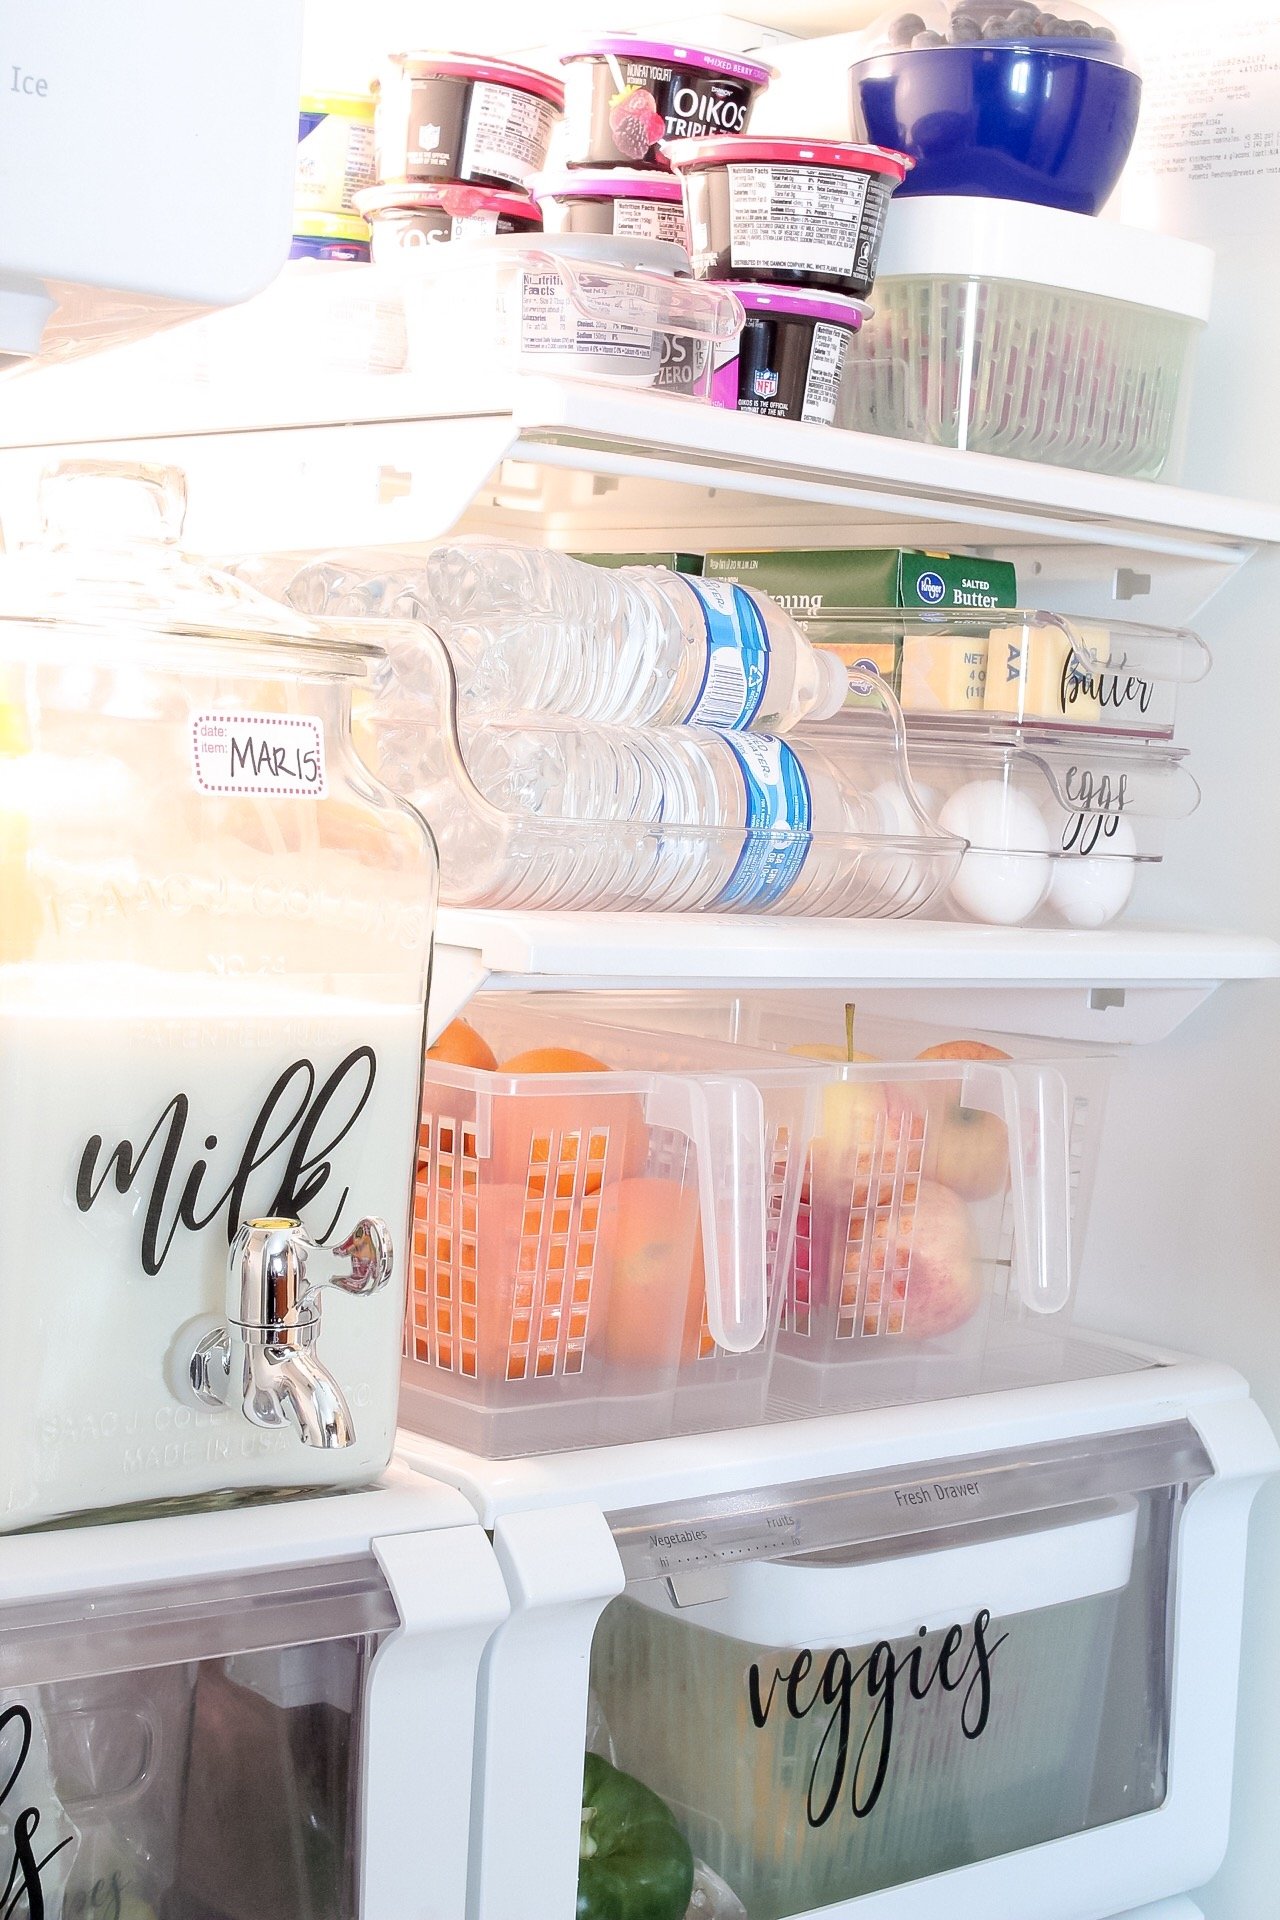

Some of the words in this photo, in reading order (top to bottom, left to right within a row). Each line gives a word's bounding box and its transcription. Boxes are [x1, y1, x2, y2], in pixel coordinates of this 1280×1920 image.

[627, 63, 649, 79] NONFAT
[649, 66, 672, 82] YOGURT
[11, 65, 48, 97] Ice
[673, 88, 747, 131] OIKOS
[641, 204, 655, 212] Facts
[576, 320, 594, 328] Cholest.
[818, 327, 833, 335] Nutrition
[833, 329, 841, 337] Facts
[658, 365, 692, 385] ZERO
[757, 381, 774, 393] NFL
[760, 400, 769, 408] THE
[769, 402, 789, 410] OFFICIAL
[920, 577, 942, 599] Kroger
[961, 579, 990, 590] SALTED
[953, 588, 998, 608] Butter
[964, 652, 984, 665] NET
[969, 670, 975, 681] 4
[200, 725, 227, 737] date:
[201, 743, 228, 753] item:
[231, 736, 296, 777] MAR
[296, 748, 317, 782] 15
[1062, 766, 1133, 855] eggs
[768, 852, 777, 864] OR
[774, 853, 785, 865] CA
[766, 868, 779, 885] CRV
[122, 1444, 190, 1473] MADE
[206, 1439, 229, 1462] IN
[894, 1486, 933, 1508] Fresh
[934, 1479, 981, 1501] Drawer
[766, 1514, 796, 1529] Fruits
[650, 1529, 708, 1549] Vegetables
[659, 1556, 670, 1568] hi
[750, 1608, 1009, 1828] veggies
